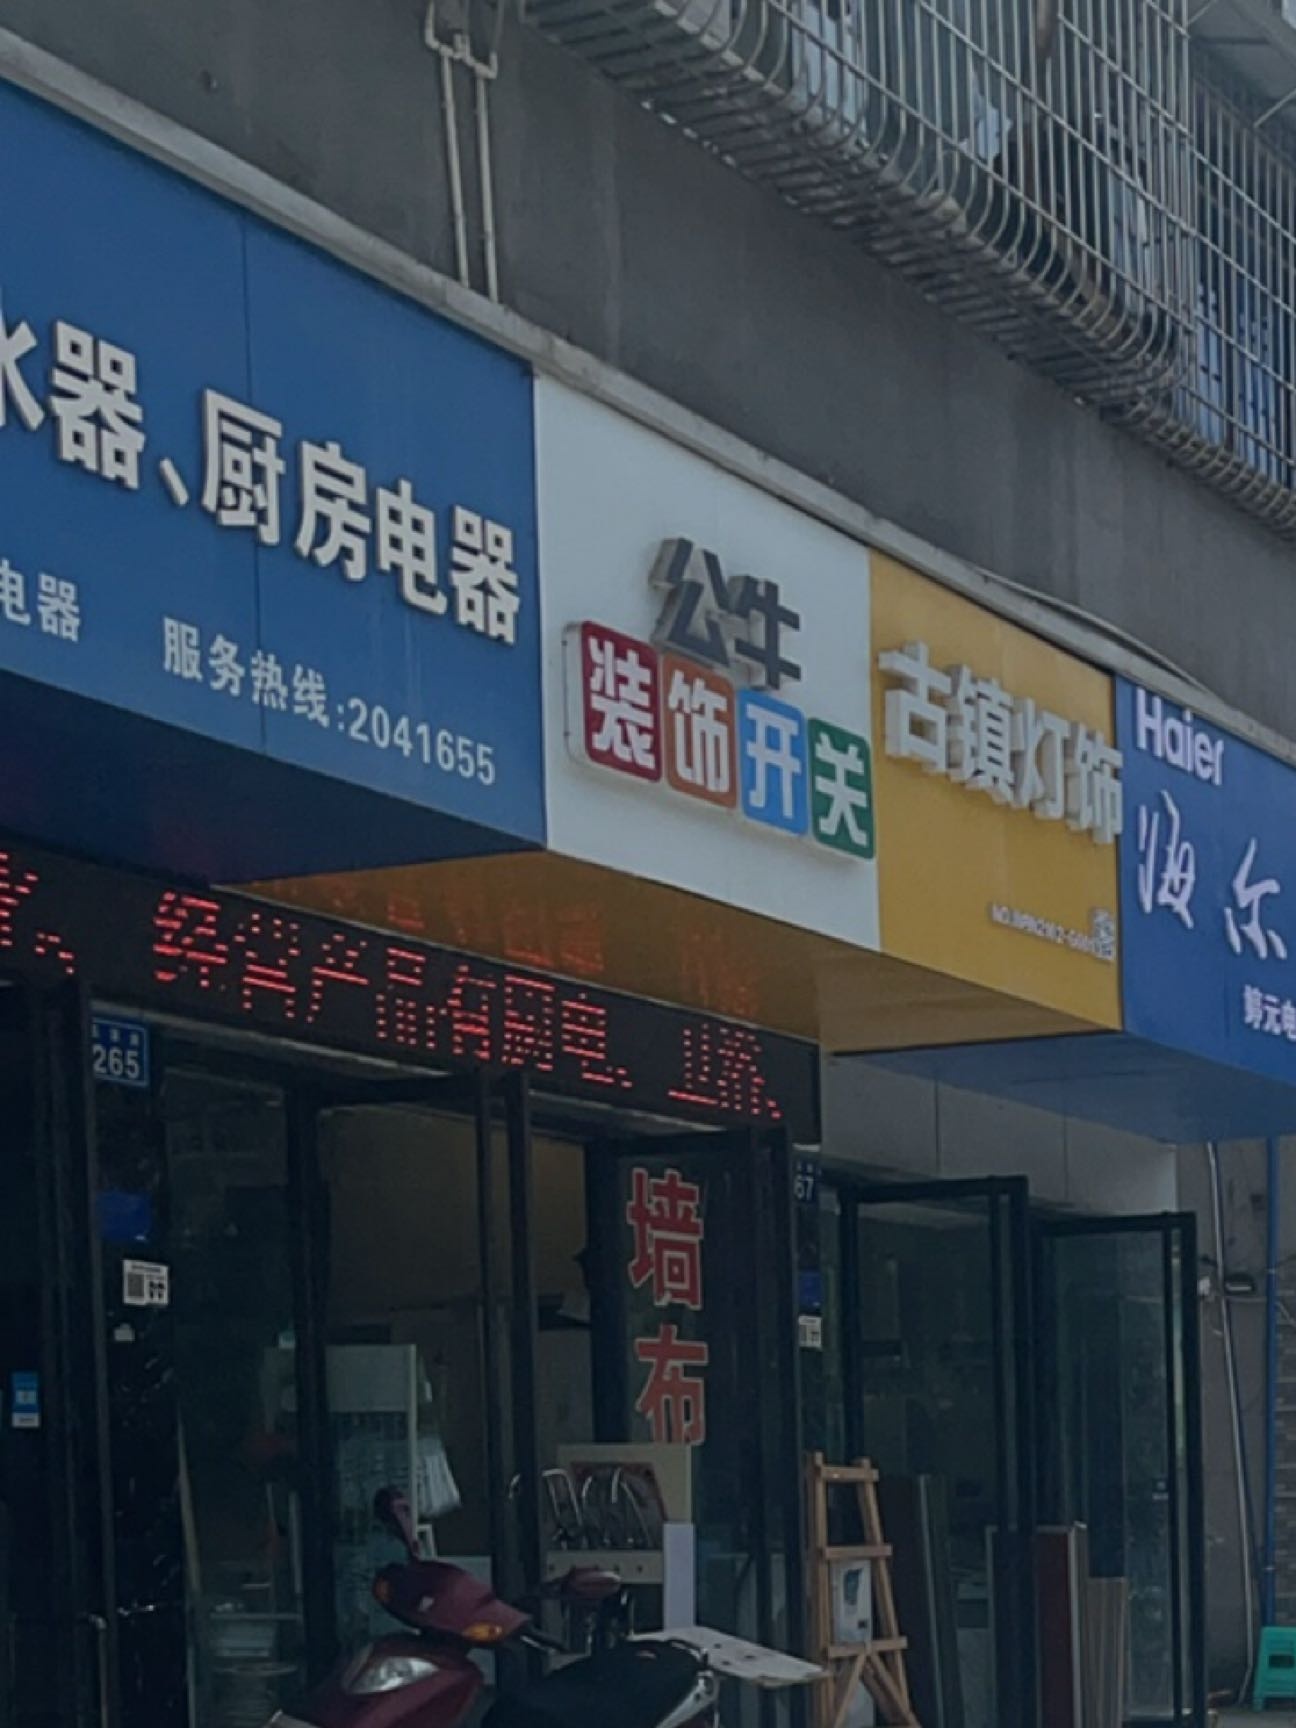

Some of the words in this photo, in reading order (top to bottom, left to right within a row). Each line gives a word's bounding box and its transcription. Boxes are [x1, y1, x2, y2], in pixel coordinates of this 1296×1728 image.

[650, 537, 801, 690] 公牛
[587, 636, 868, 848] 装饰开关
[878, 640, 1123, 845] 古镇灯饰
[1136, 686, 1224, 786] Haier
[1138, 787, 1287, 960] 海尔
[92, 1043, 140, 1080] 265
[626, 1167, 709, 1446] 墙布
